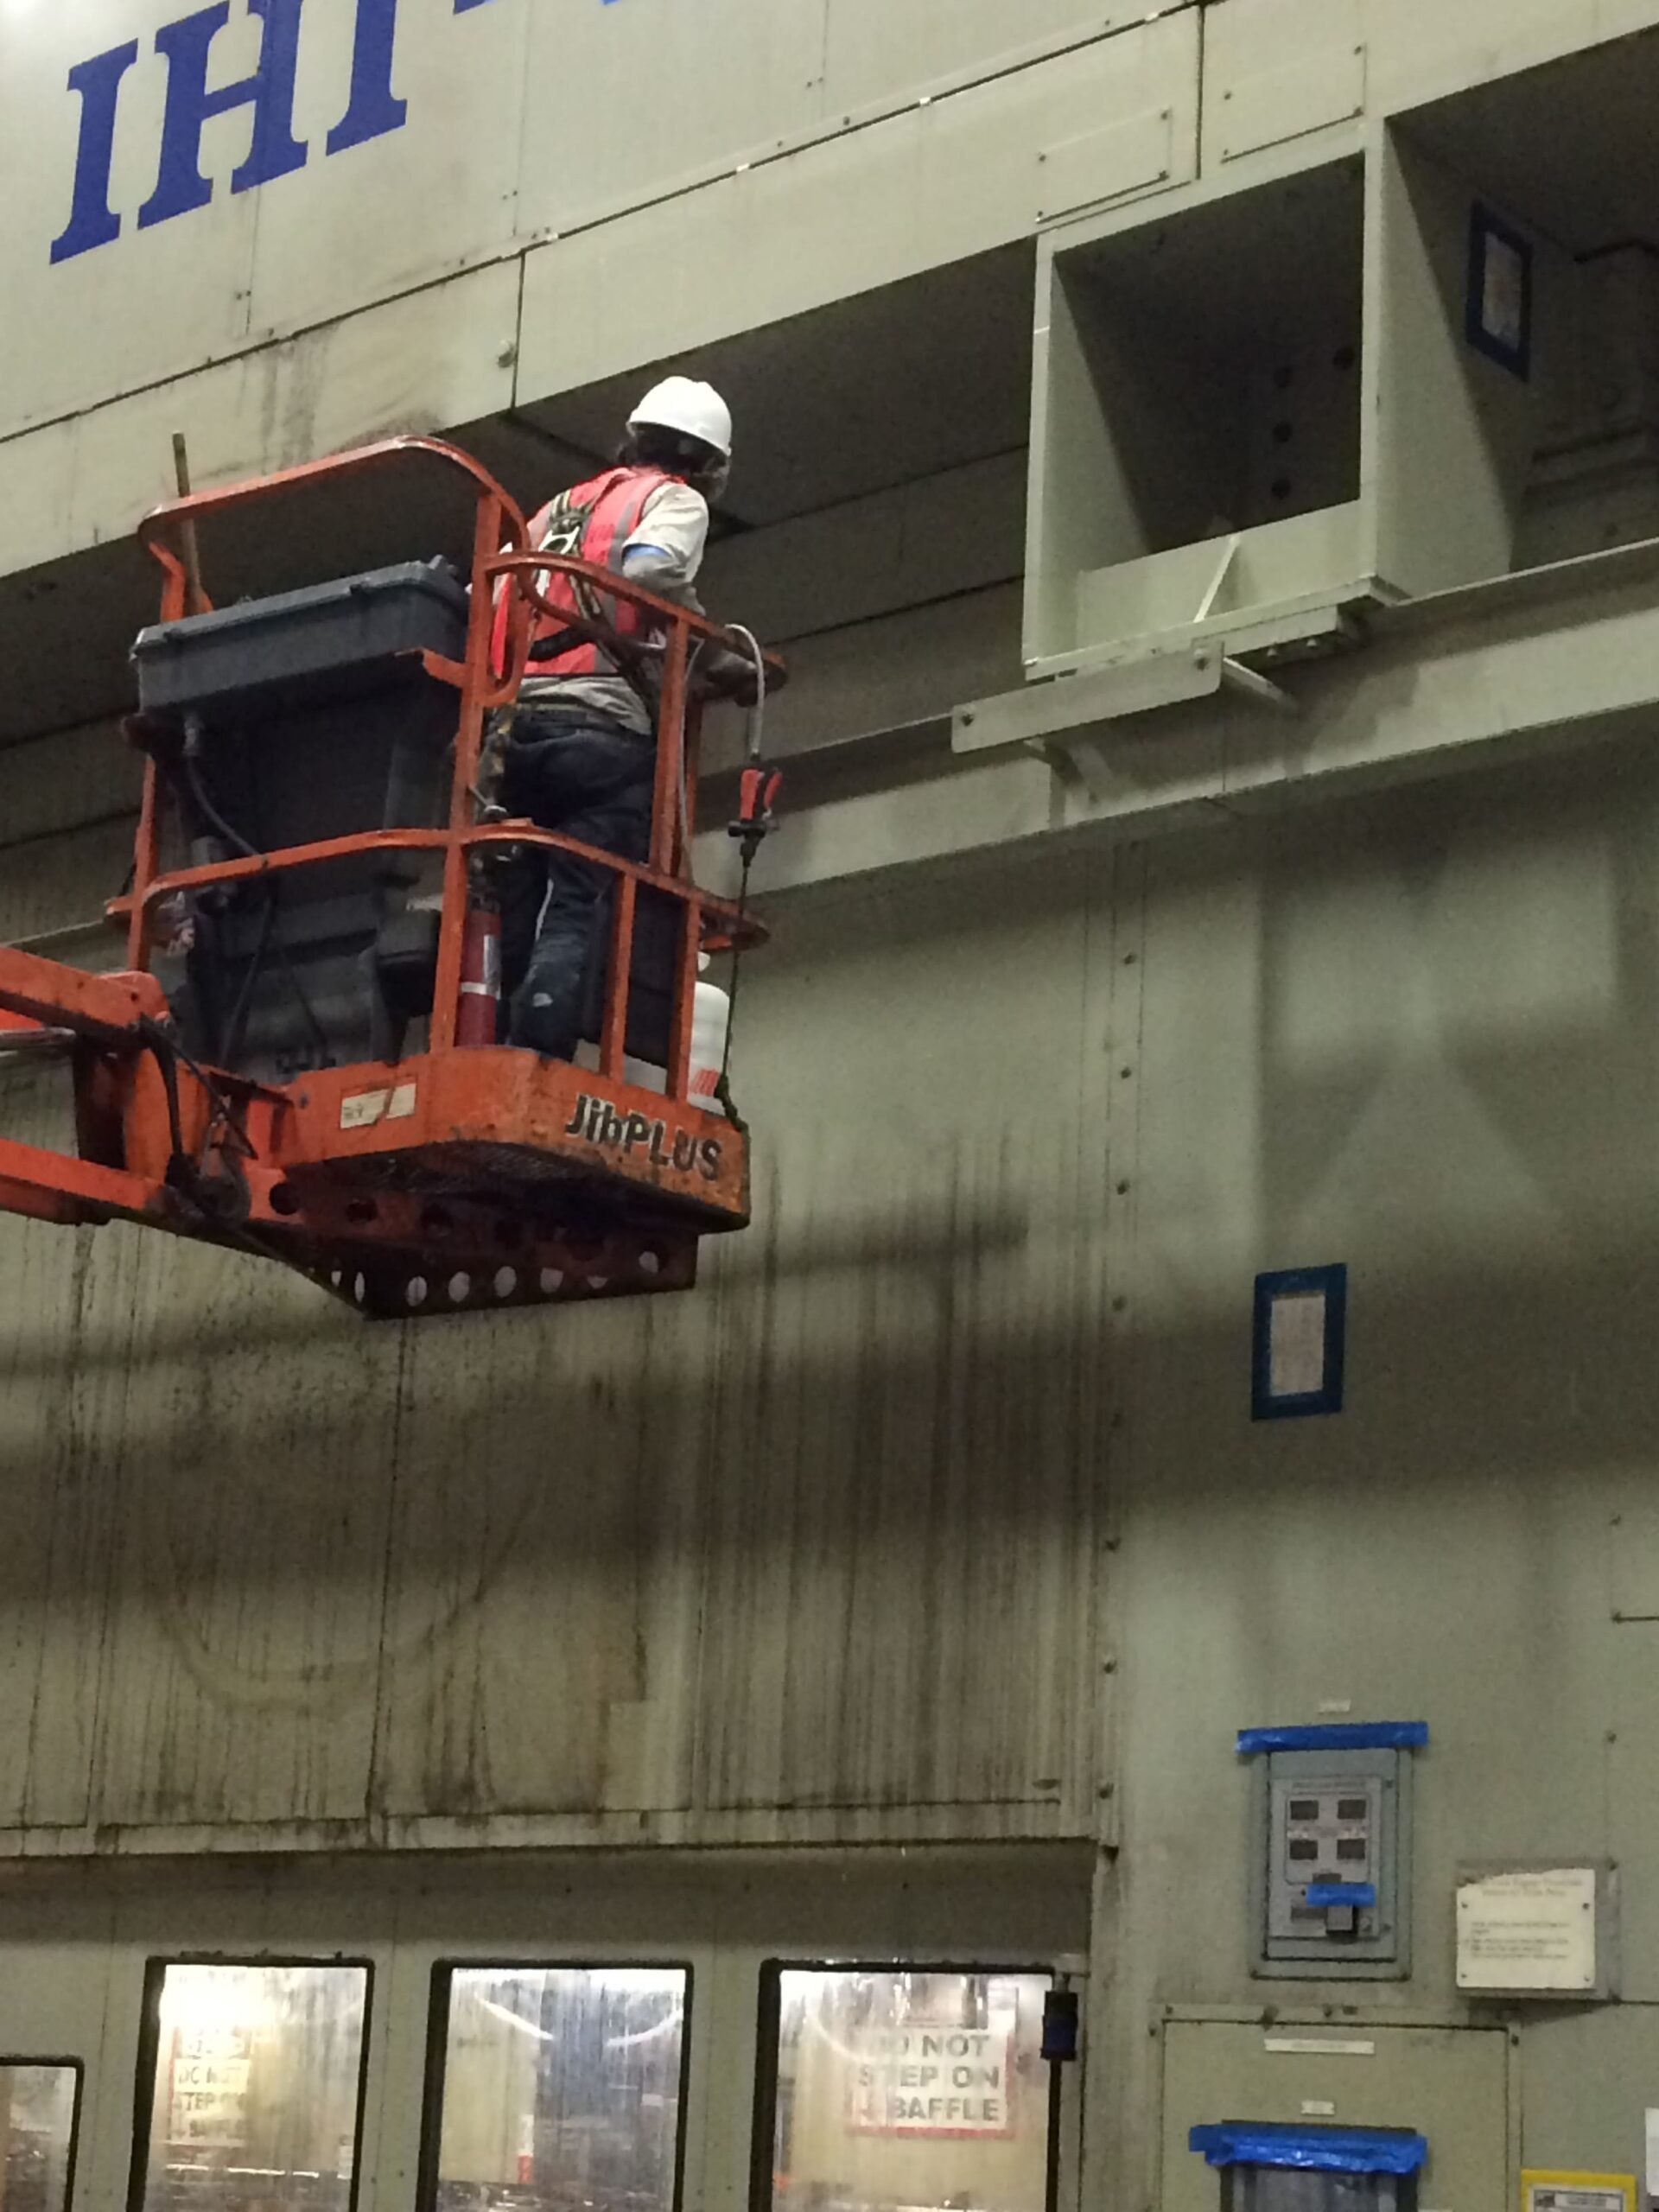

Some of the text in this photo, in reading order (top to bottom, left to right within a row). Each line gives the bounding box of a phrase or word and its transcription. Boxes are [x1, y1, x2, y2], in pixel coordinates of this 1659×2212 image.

[50, 0, 407, 264] IHI
[565, 1093, 721, 1181] JibPLUS
[922, 2034, 991, 2058] NOT
[858, 2064, 999, 2089] STEP ON
[888, 2095, 999, 2121] BAFFLE
